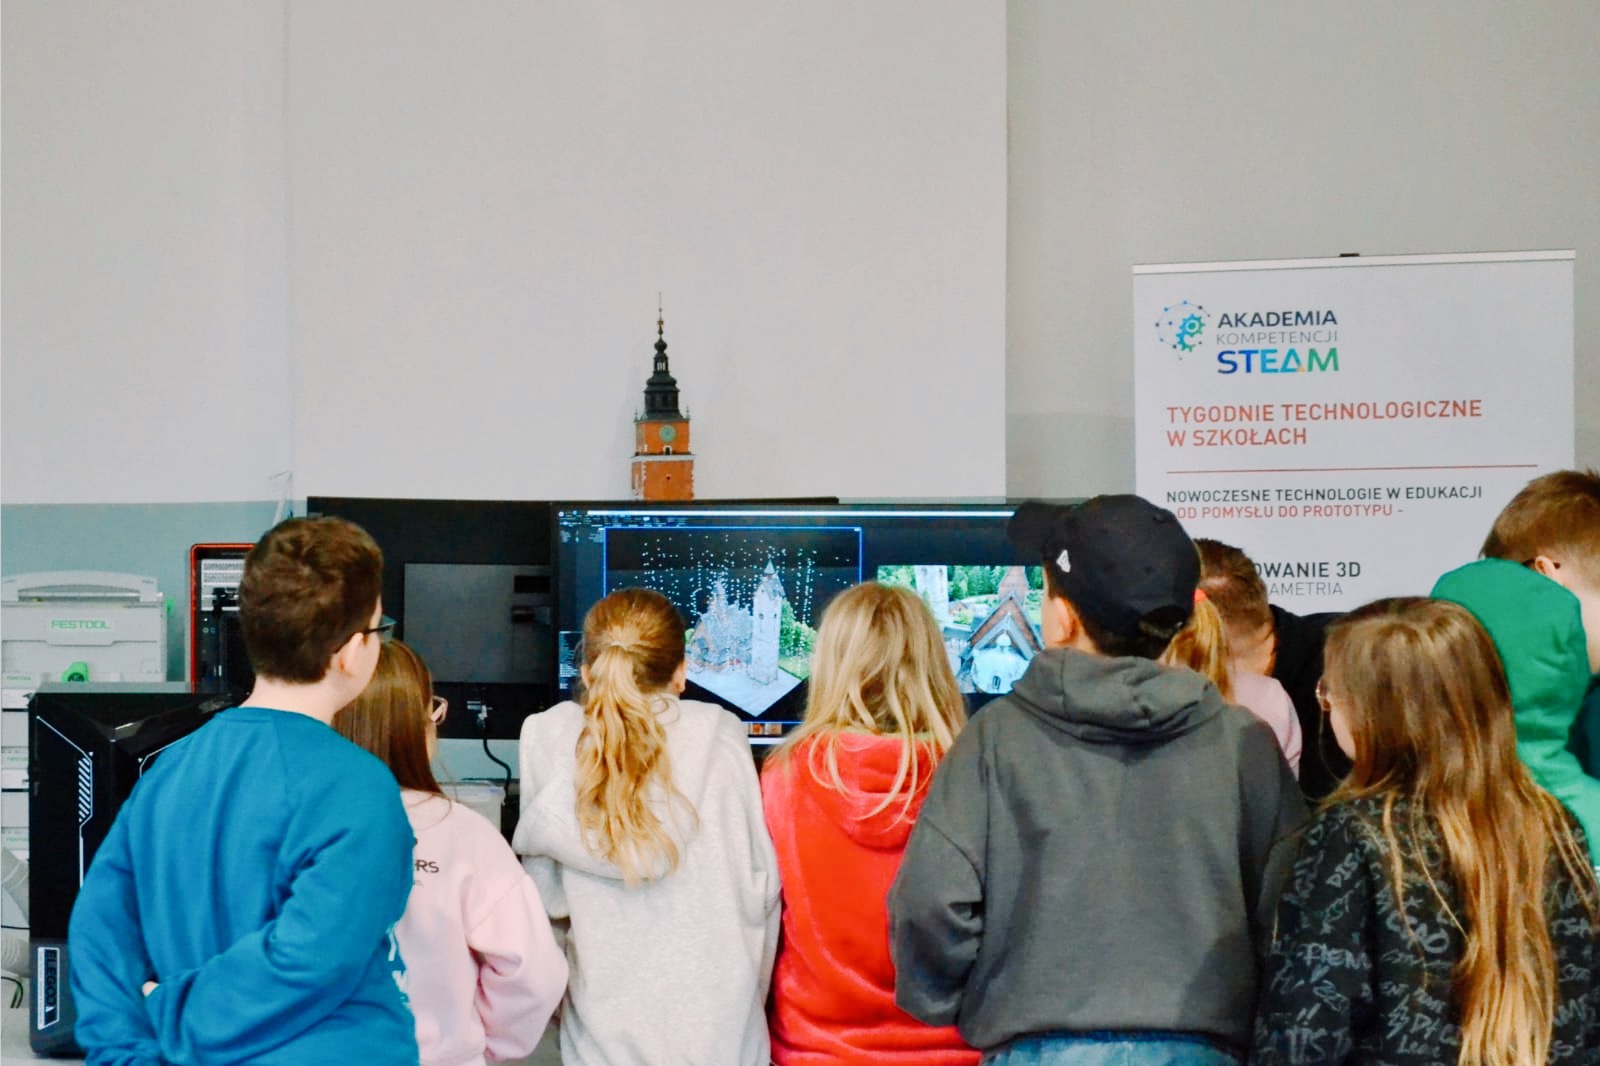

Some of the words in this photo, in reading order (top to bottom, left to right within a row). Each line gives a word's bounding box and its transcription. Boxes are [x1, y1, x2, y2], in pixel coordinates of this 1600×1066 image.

[1217, 310, 1338, 328] AKADEMIA
[1216, 330, 1338, 345] KOMPETENCJI
[1217, 348, 1339, 374] STEAM
[1166, 404, 1275, 423] TYGODNIE
[1281, 399, 1483, 421] TECHNOLOGICZNE
[1166, 429, 1186, 447] W
[1192, 427, 1307, 446] SZKOŁACH
[1166, 489, 1271, 503] NOWOCZESNE
[1275, 488, 1382, 501] TECHNOLOGIE
[1387, 487, 1401, 499] W
[1406, 486, 1482, 499] EDUKACJI
[1177, 507, 1197, 519] OD
[1202, 505, 1274, 518] POMYSŁU
[1278, 505, 1298, 518] DO
[1303, 504, 1392, 517] PROTOTYPU
[1336, 562, 1361, 577] 3D
[1269, 582, 1343, 596] AMETRIA
